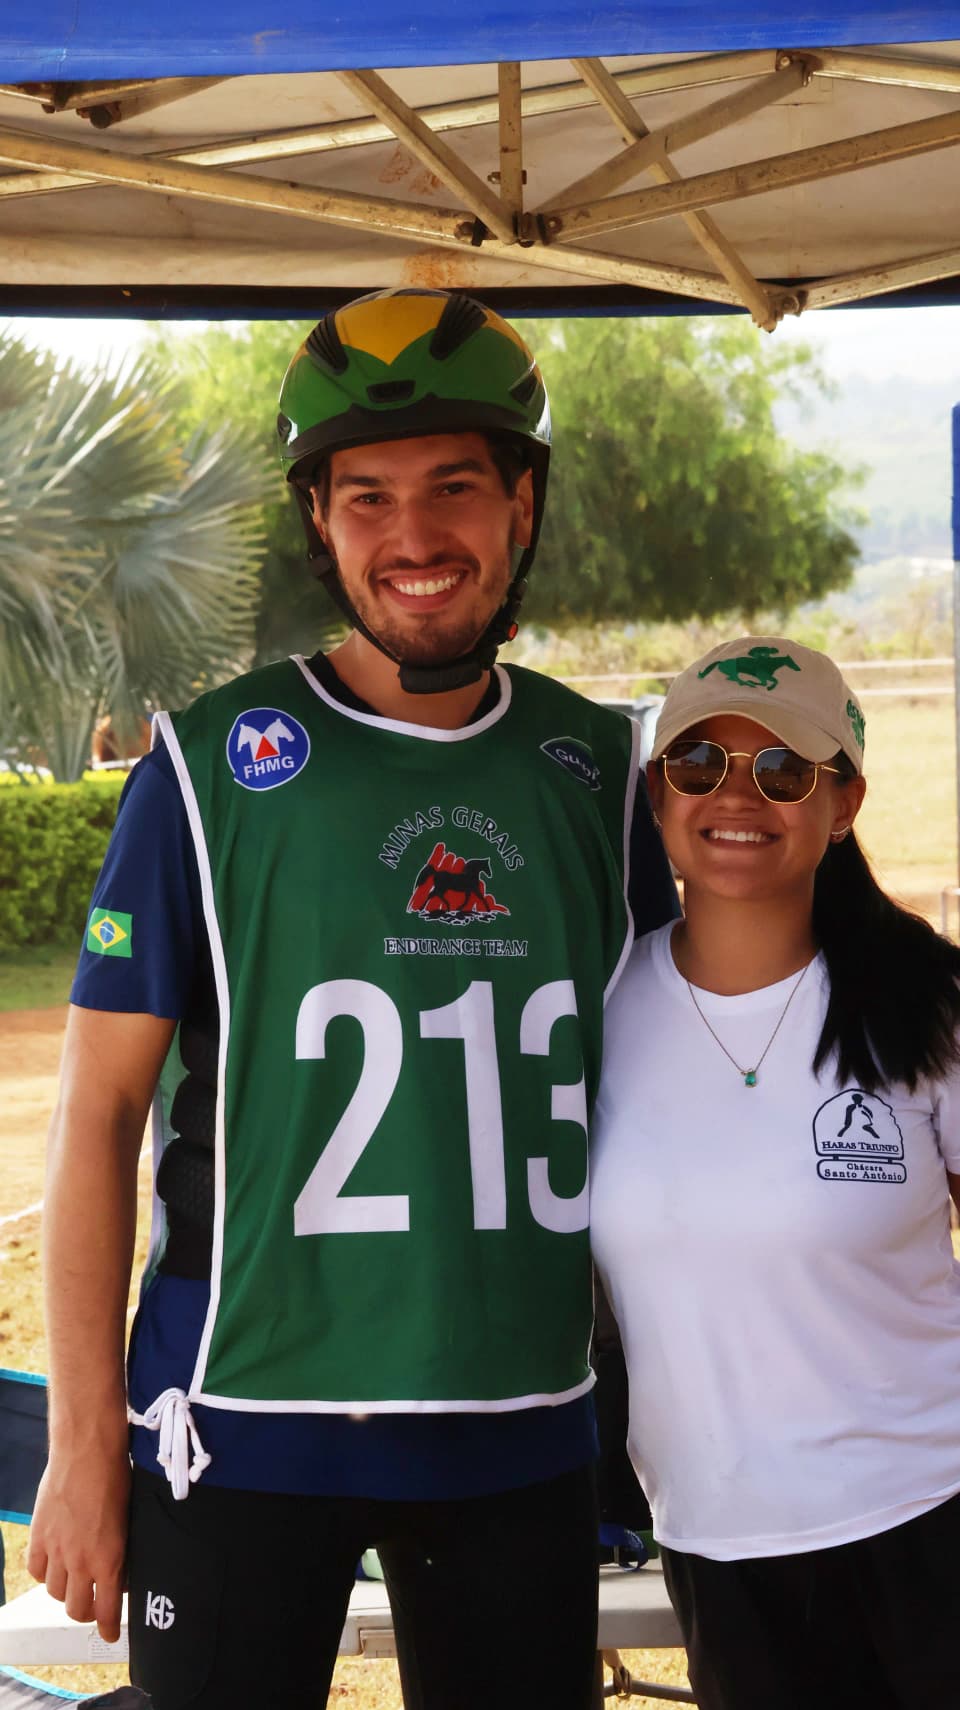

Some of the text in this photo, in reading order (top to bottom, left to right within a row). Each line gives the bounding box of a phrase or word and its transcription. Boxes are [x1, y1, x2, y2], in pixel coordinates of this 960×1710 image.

[243, 755, 295, 779] FHMG
[378, 806, 524, 871] MINAS GERAIS
[384, 938, 528, 957] ENDURANCE TEAM
[294, 979, 590, 1236] 213
[824, 1168, 902, 1181] Santo Antônio
